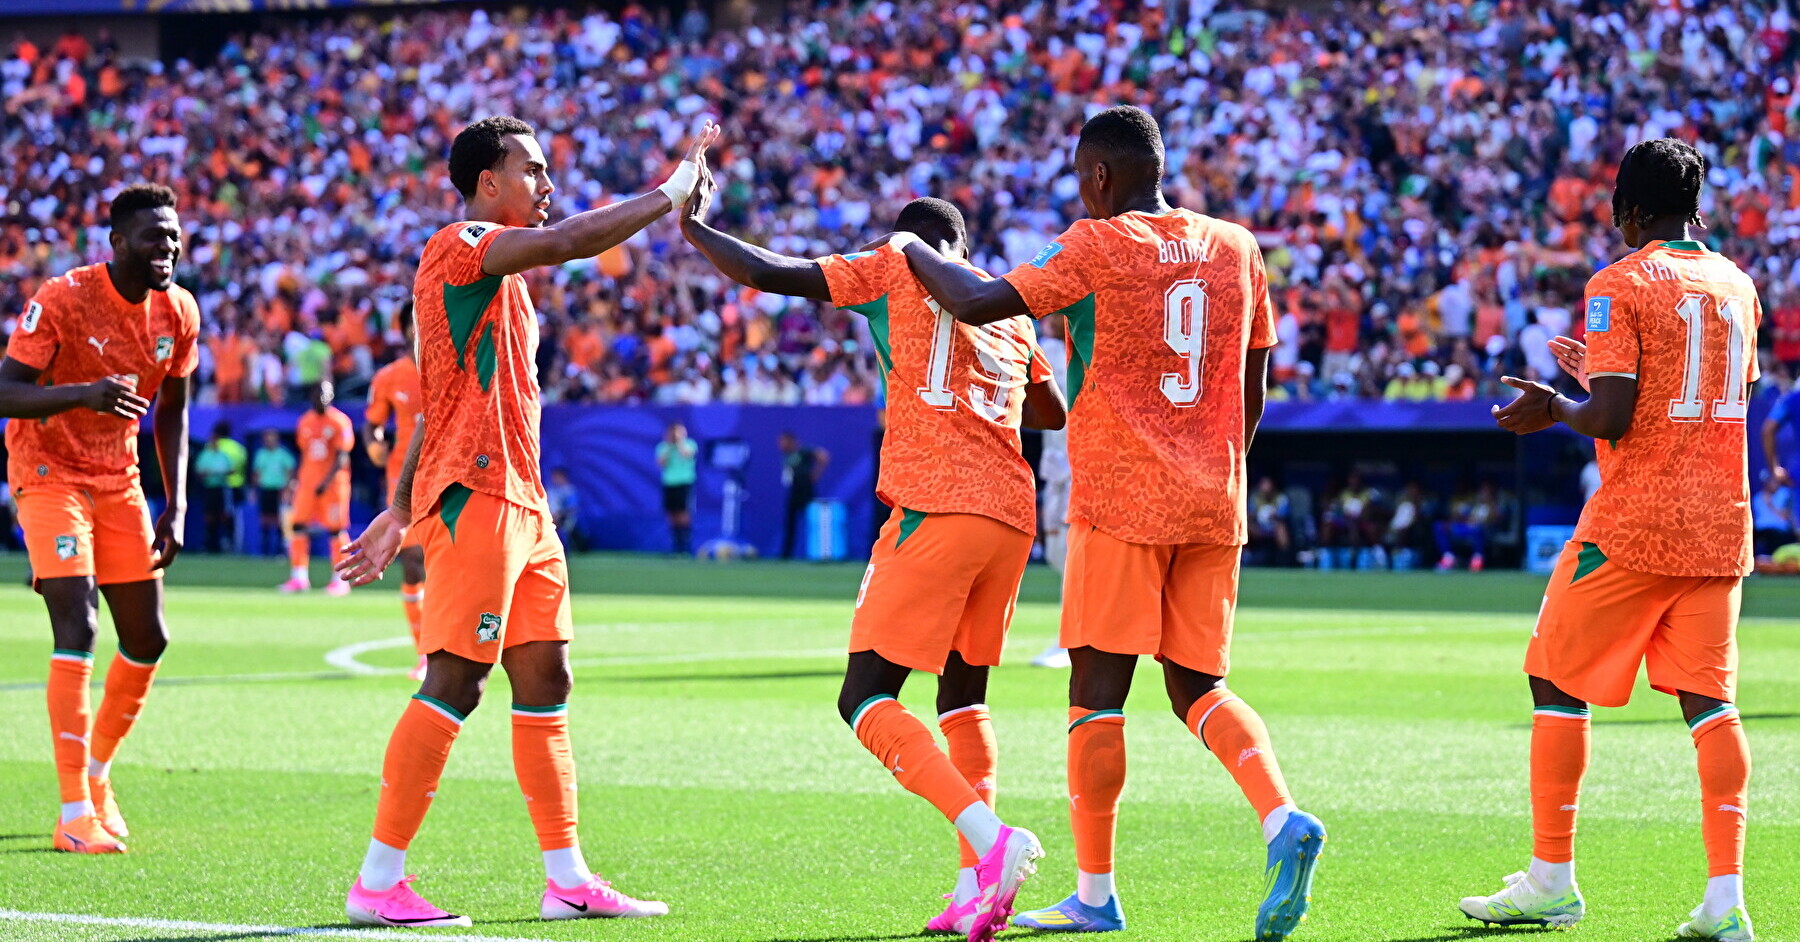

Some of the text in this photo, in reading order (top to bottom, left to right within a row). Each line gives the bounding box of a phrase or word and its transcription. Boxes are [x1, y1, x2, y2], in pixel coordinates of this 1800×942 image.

[916, 295, 1012, 424] 19
[1159, 279, 1208, 407] 9
[1667, 293, 1745, 423] 11
